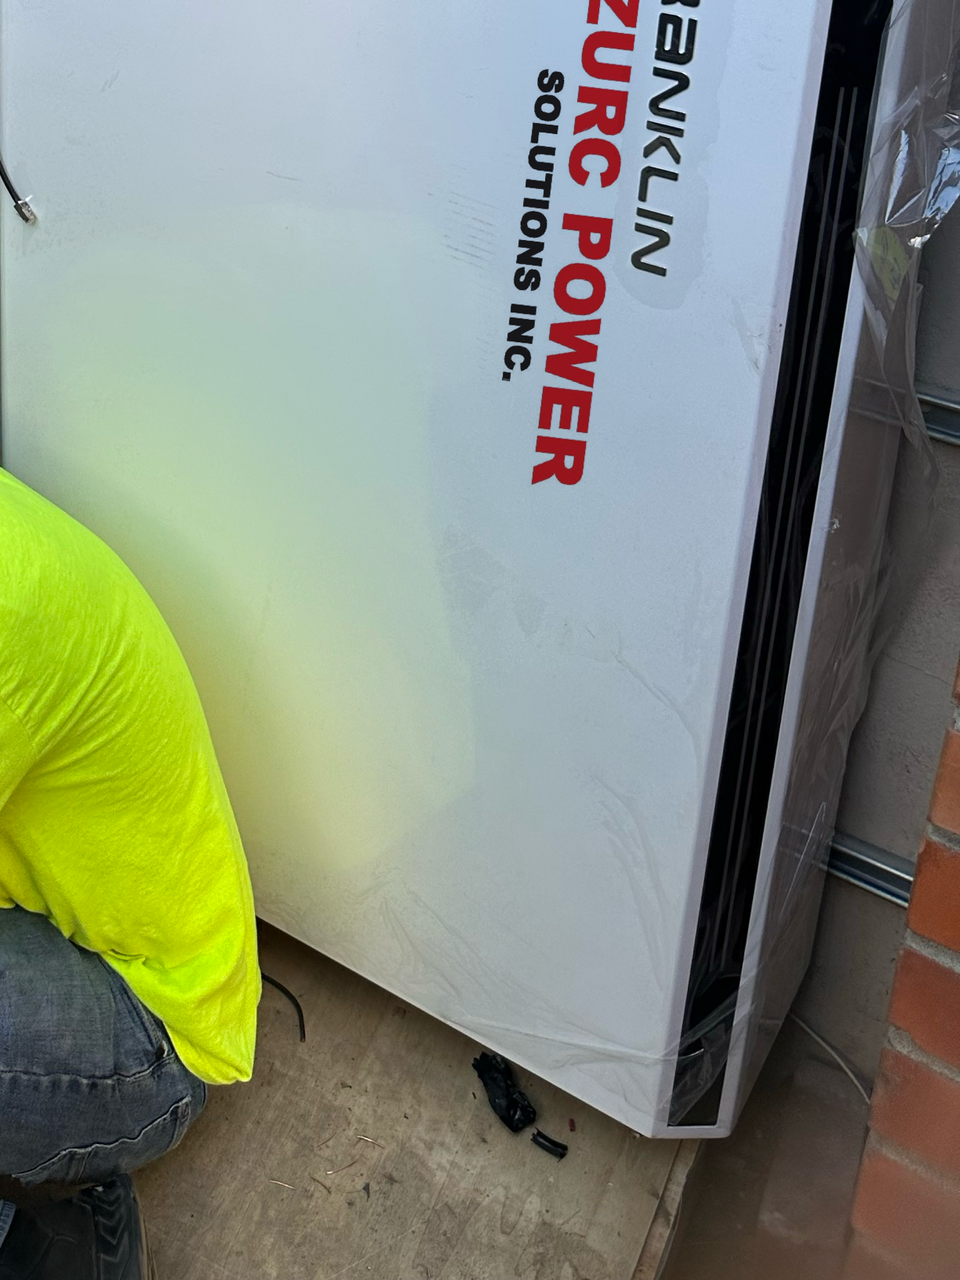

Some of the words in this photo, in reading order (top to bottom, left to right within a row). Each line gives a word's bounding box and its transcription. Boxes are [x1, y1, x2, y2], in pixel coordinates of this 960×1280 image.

[513, 68, 565, 292] SOLUTIONS
[501, 303, 537, 382] INC.
[531, 213, 614, 486] POWER
